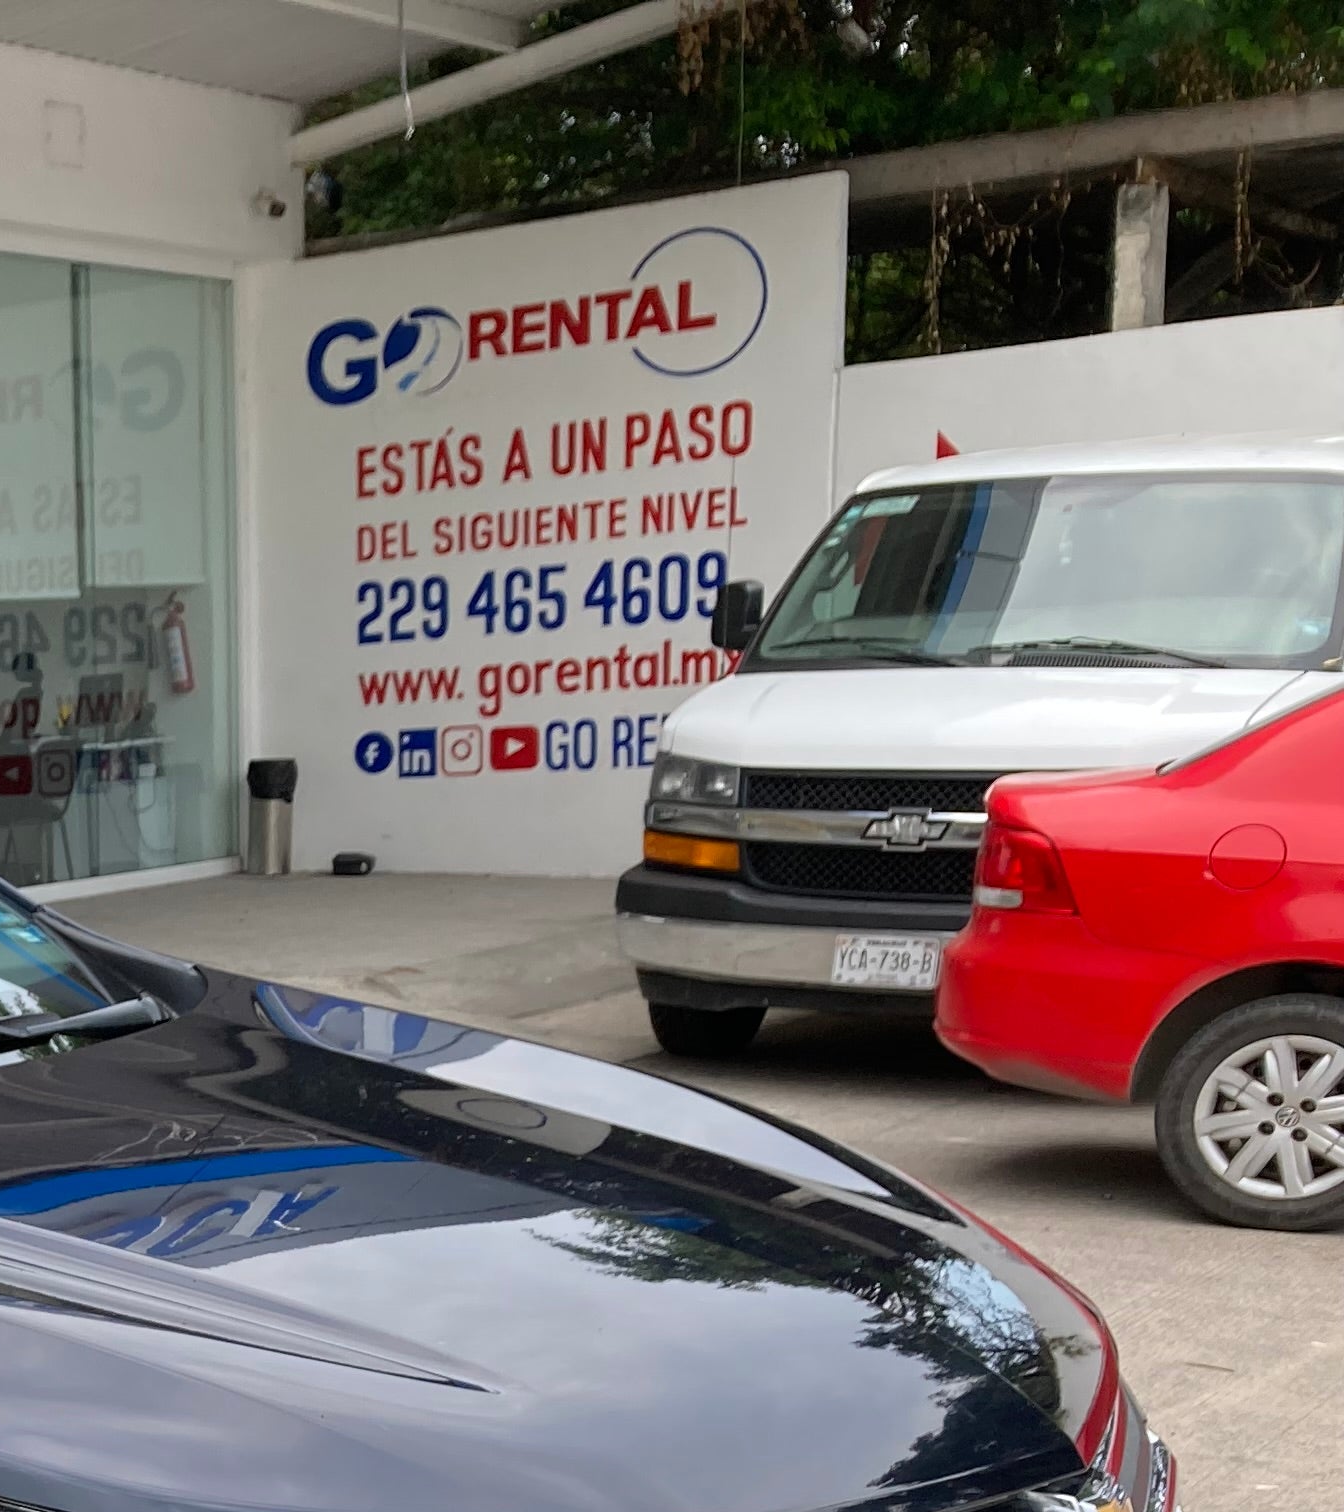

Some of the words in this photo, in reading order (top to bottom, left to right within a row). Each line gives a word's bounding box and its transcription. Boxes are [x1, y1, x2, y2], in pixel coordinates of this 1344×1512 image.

[468, 279, 717, 361] RENTAL
[355, 427, 483, 499] ESTÁS
[502, 427, 532, 484] A
[551, 416, 608, 477] UN
[624, 400, 753, 472] PASO
[355, 523, 418, 564] DEL
[433, 498, 628, 556] SIGUIENTE
[641, 486, 748, 537] NIVEL
[357, 575, 449, 646] 229
[467, 563, 567, 637] 465
[583, 550, 728, 628] 4609
[544, 716, 598, 772] GO
